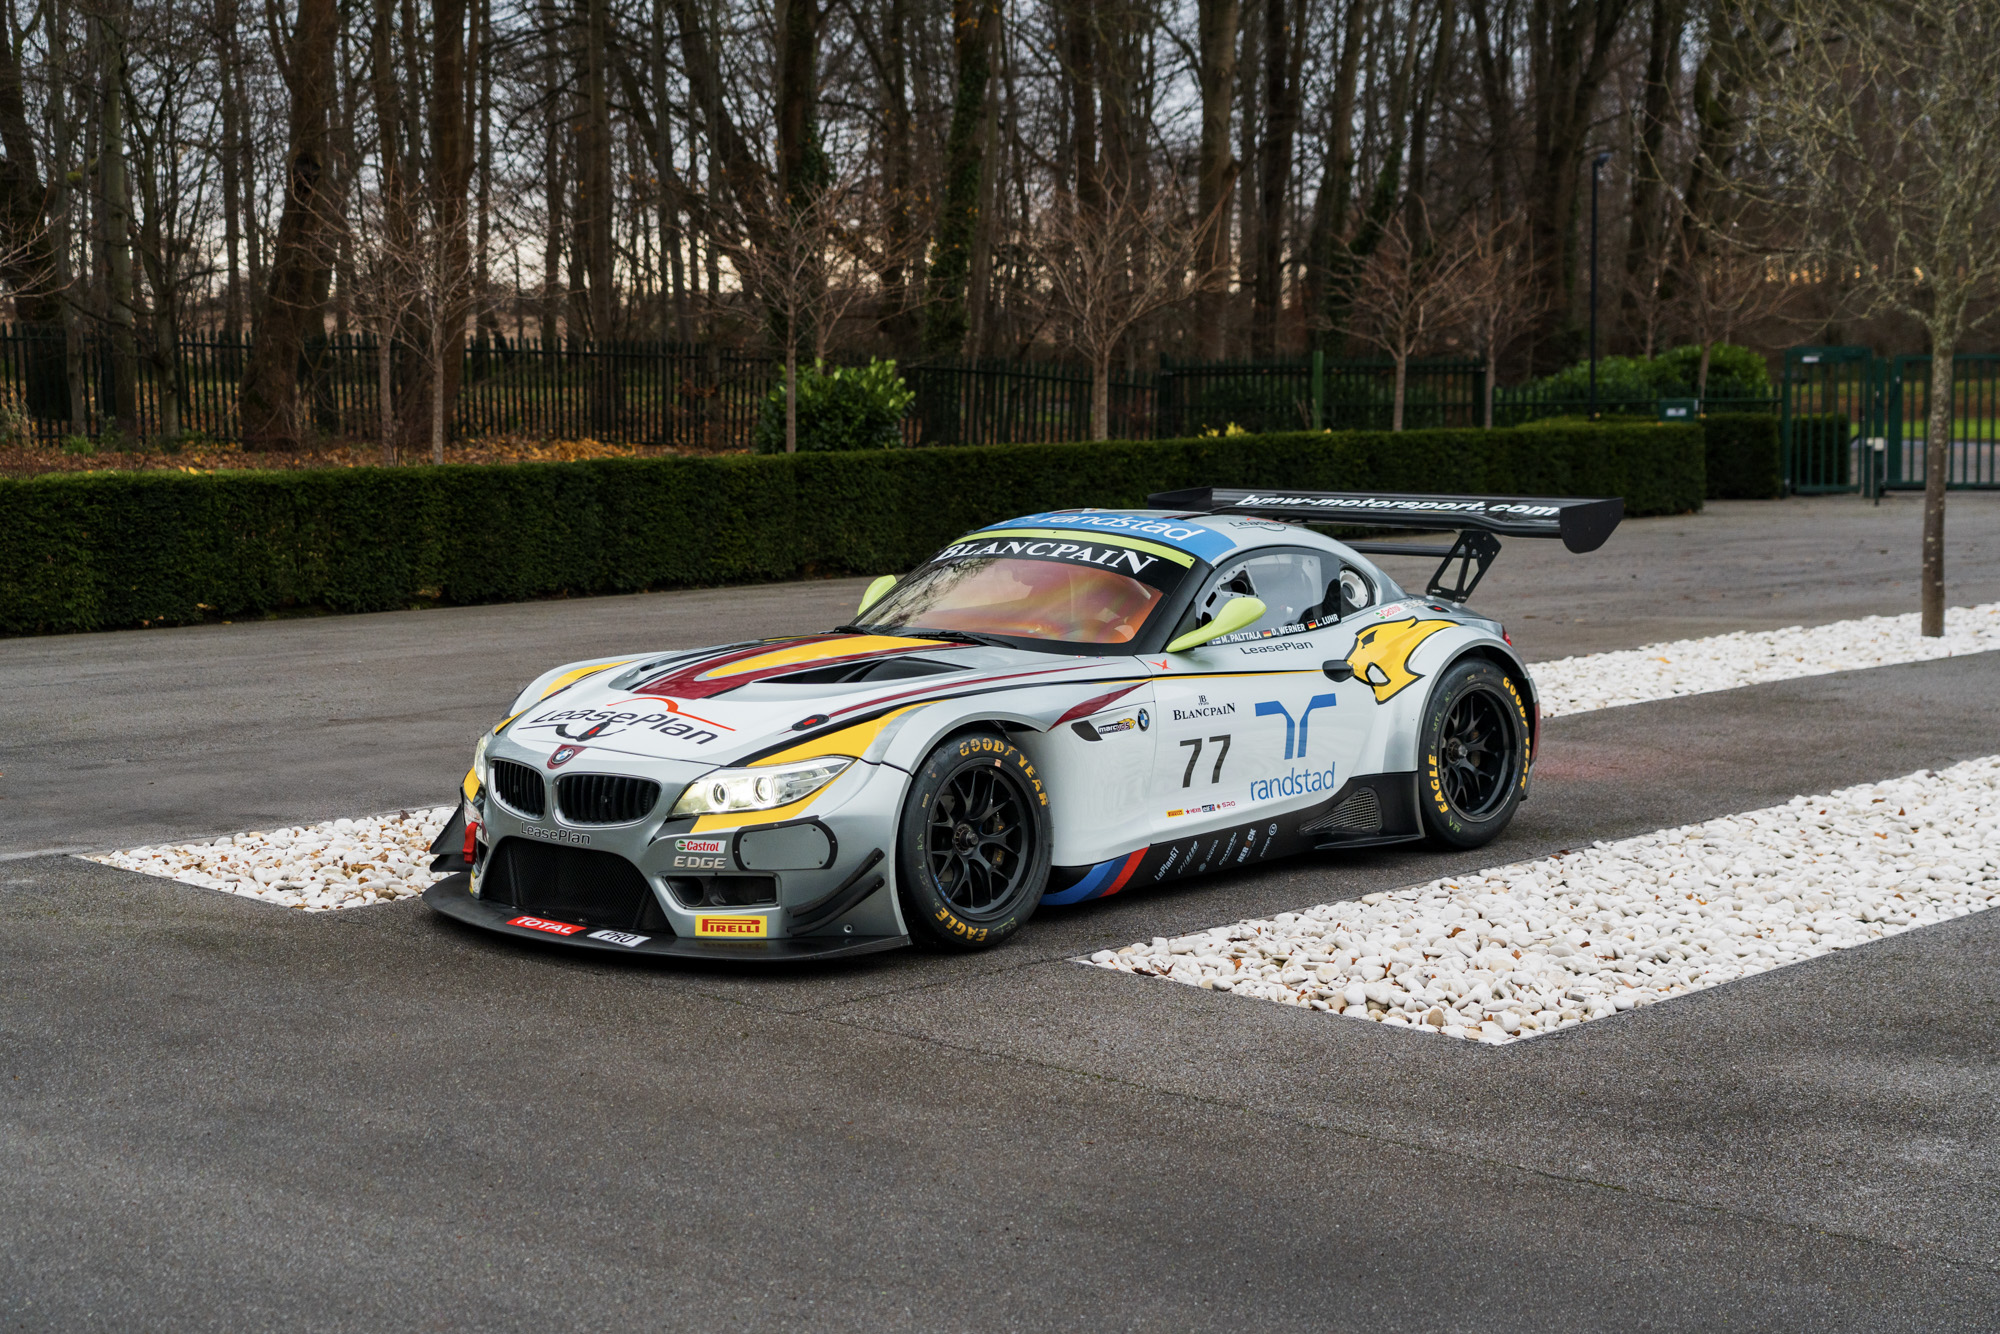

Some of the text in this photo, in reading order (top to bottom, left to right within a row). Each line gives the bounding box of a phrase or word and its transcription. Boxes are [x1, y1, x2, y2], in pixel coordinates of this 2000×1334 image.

[1235, 494, 1560, 516] bmw-motorsport.com
[1038, 513, 1206, 542] randstad
[930, 541, 1159, 575] BLANCPAIN
[1220, 613, 1340, 644] M. PALTTALA D. WERNER L. LUHR
[1239, 641, 1314, 655] LeasePlan
[1173, 703, 1236, 720] BLANCPAIN
[529, 709, 719, 745] LeasePlan
[1180, 734, 1231, 788] 77
[1250, 761, 1336, 801] randstad
[1428, 754, 1449, 813] EAGLE
[520, 822, 591, 845] LeasePlan
[687, 841, 719, 852] Castrol
[673, 856, 727, 869] EDGE
[1154, 846, 1179, 880] LePlanGT
[517, 916, 572, 935] TOTAL
[702, 918, 761, 933] PIRELLI
[935, 907, 988, 942] EAGLE
